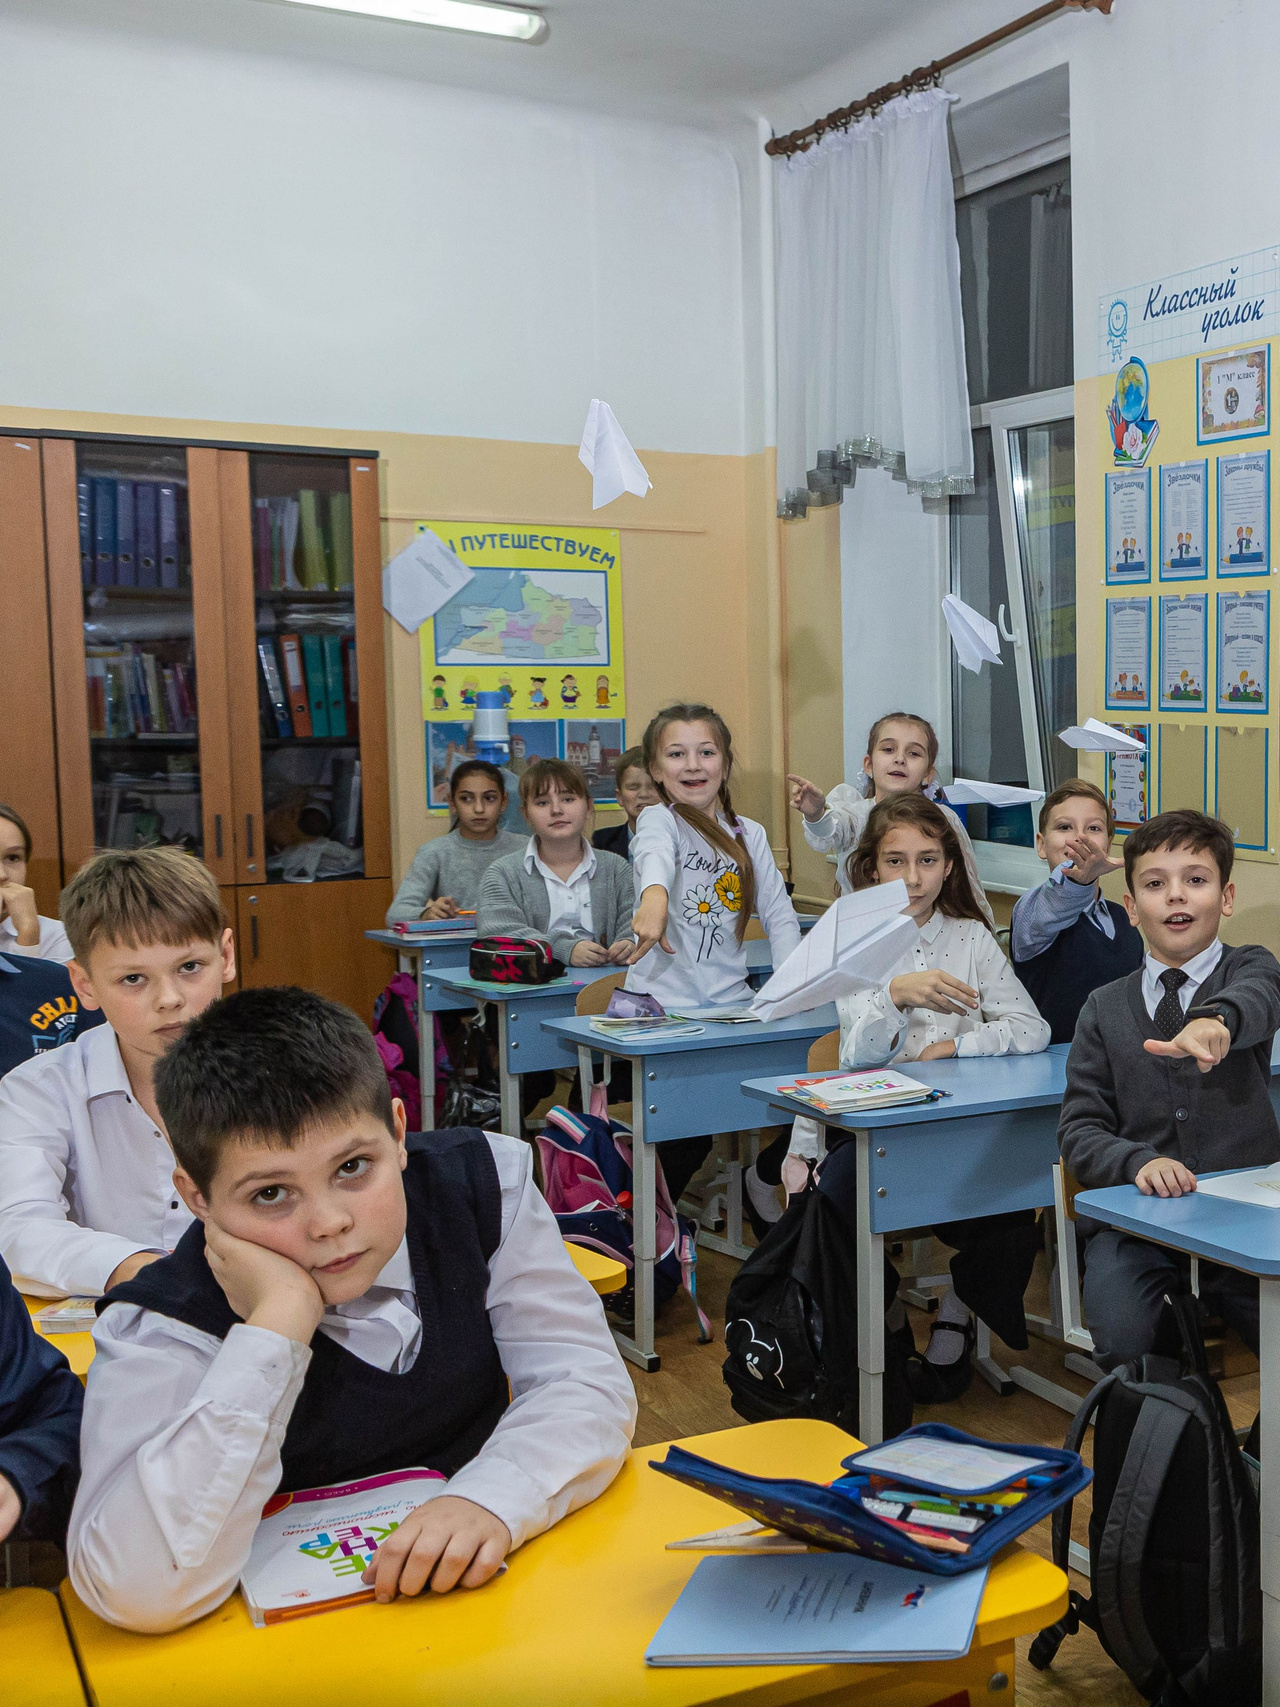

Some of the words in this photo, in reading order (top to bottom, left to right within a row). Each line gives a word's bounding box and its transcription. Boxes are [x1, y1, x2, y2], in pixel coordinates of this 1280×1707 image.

[1143, 267, 1238, 320] Классный
[1202, 299, 1264, 343] уголок
[1238, 370, 1256, 382] класс
[1224, 464, 1243, 476] Законы
[1244, 462, 1264, 472] дружбы
[461, 533, 616, 569] ПУТЕШЕСТВУЕМ
